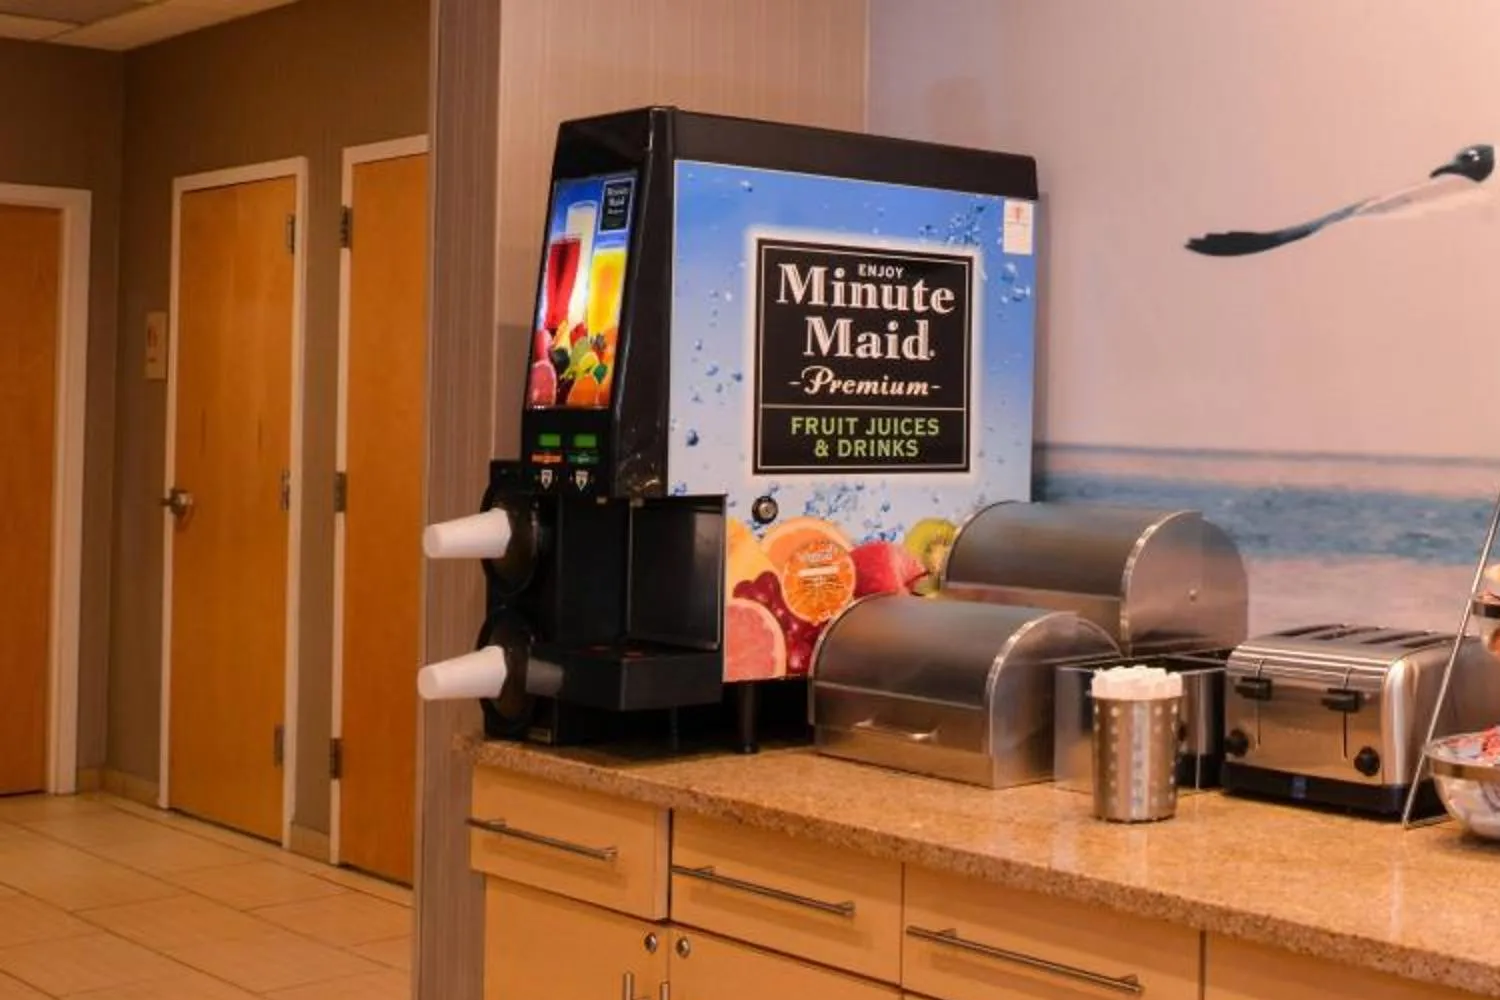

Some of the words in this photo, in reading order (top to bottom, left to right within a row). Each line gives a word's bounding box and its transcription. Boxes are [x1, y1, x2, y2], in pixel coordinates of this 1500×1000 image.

[858, 263, 904, 278] ENJOY
[776, 263, 955, 314] Minute
[803, 316, 930, 361] Maid
[791, 416, 859, 435] FRUIT
[865, 417, 940, 435] JUICES
[814, 439, 829, 458] &
[838, 439, 919, 458] DRINKS
